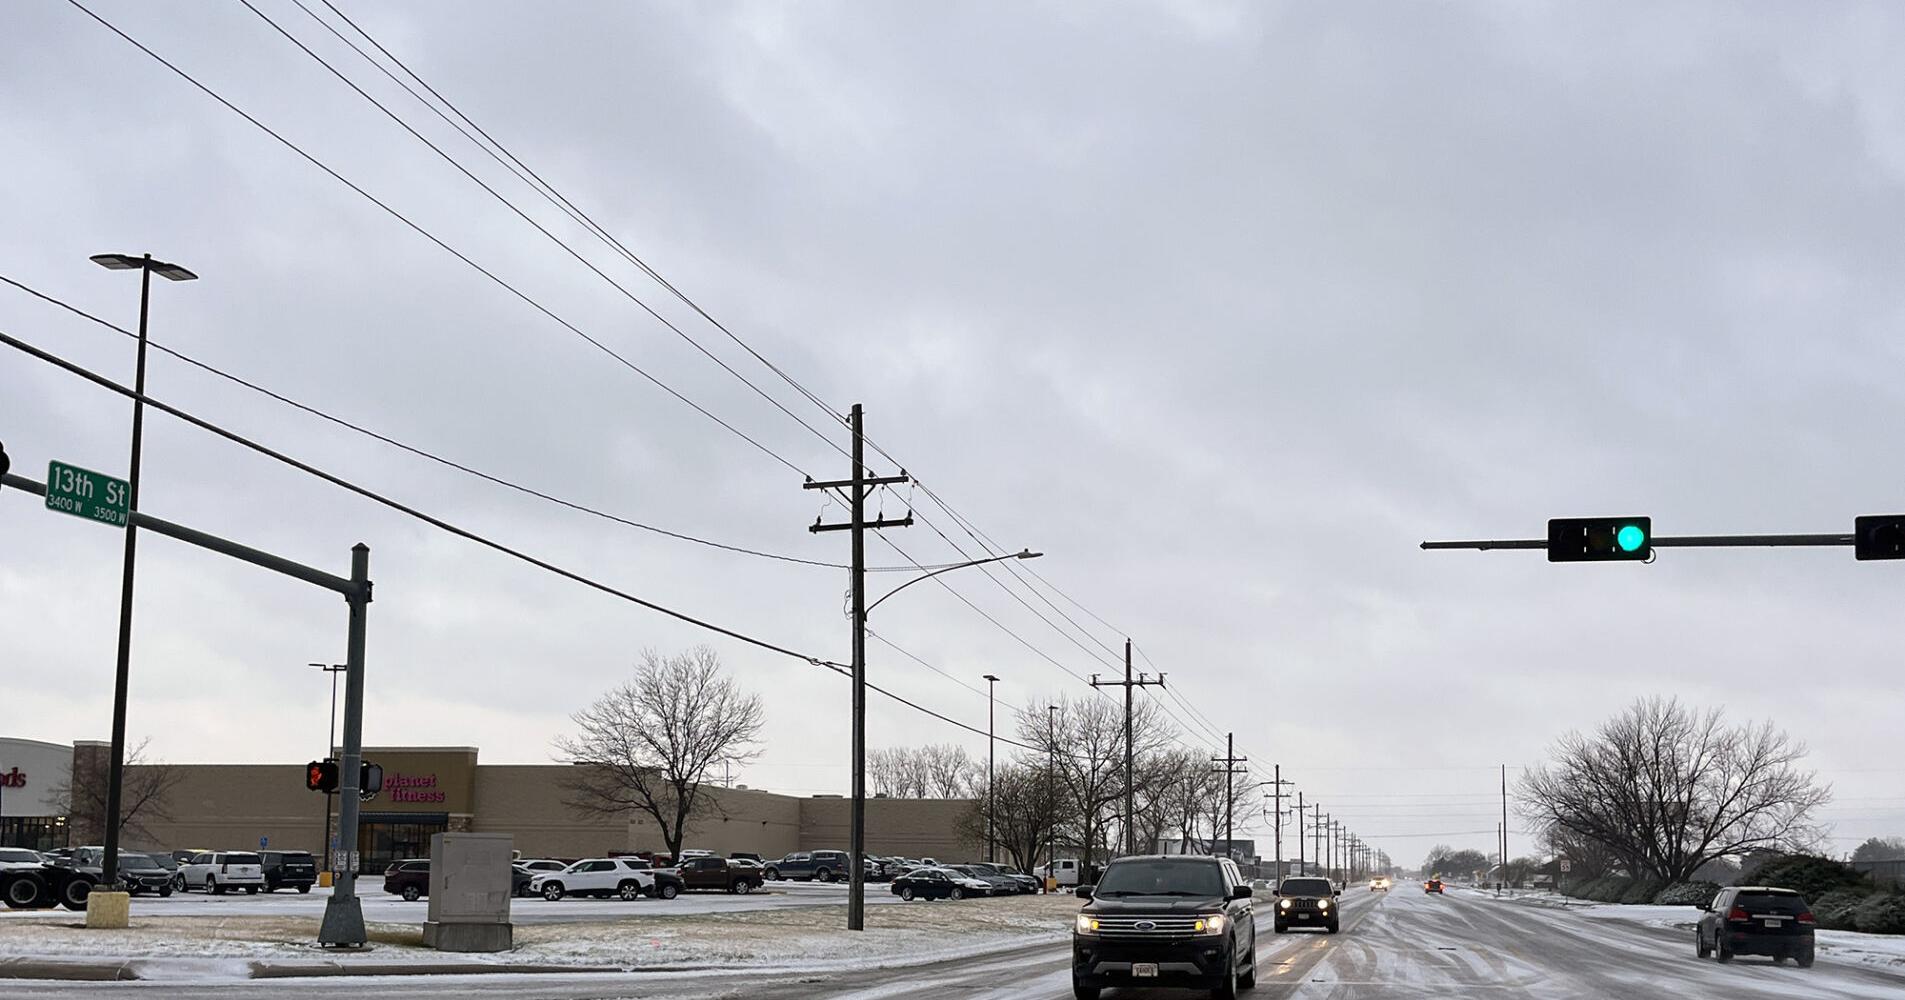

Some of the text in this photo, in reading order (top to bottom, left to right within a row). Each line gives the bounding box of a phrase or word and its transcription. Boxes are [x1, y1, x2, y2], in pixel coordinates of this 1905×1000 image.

[55, 466, 125, 507] 13th St
[48, 494, 127, 525] 3400 W 3500 W
[383, 773, 436, 790] planet
[391, 788, 445, 802] fitness
